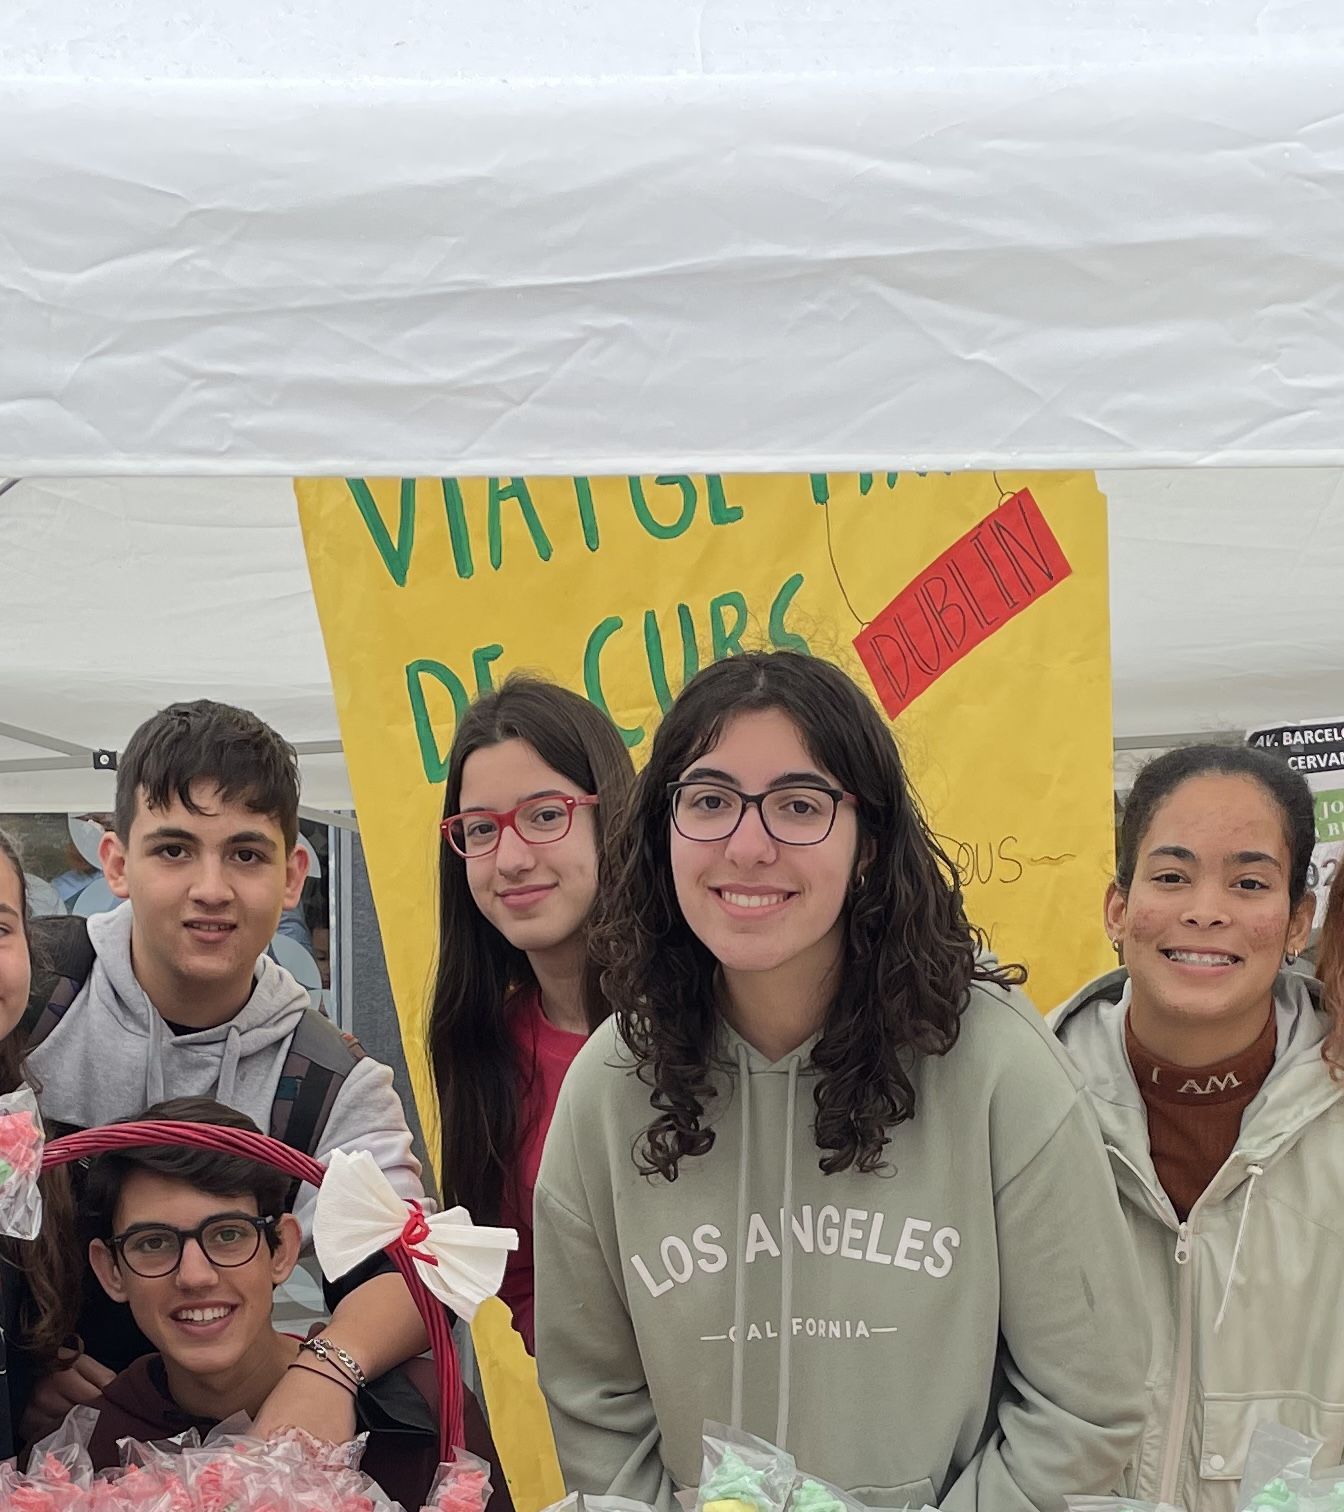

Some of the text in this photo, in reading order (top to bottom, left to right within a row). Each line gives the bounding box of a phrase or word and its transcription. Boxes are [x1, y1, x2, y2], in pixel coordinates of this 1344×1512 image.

[1254, 733, 1279, 749] AV.
[1151, 1065, 1243, 1095] I AM
[630, 1204, 961, 1298] LOS ANGELES
[727, 1317, 870, 1344] CALFORNIA
